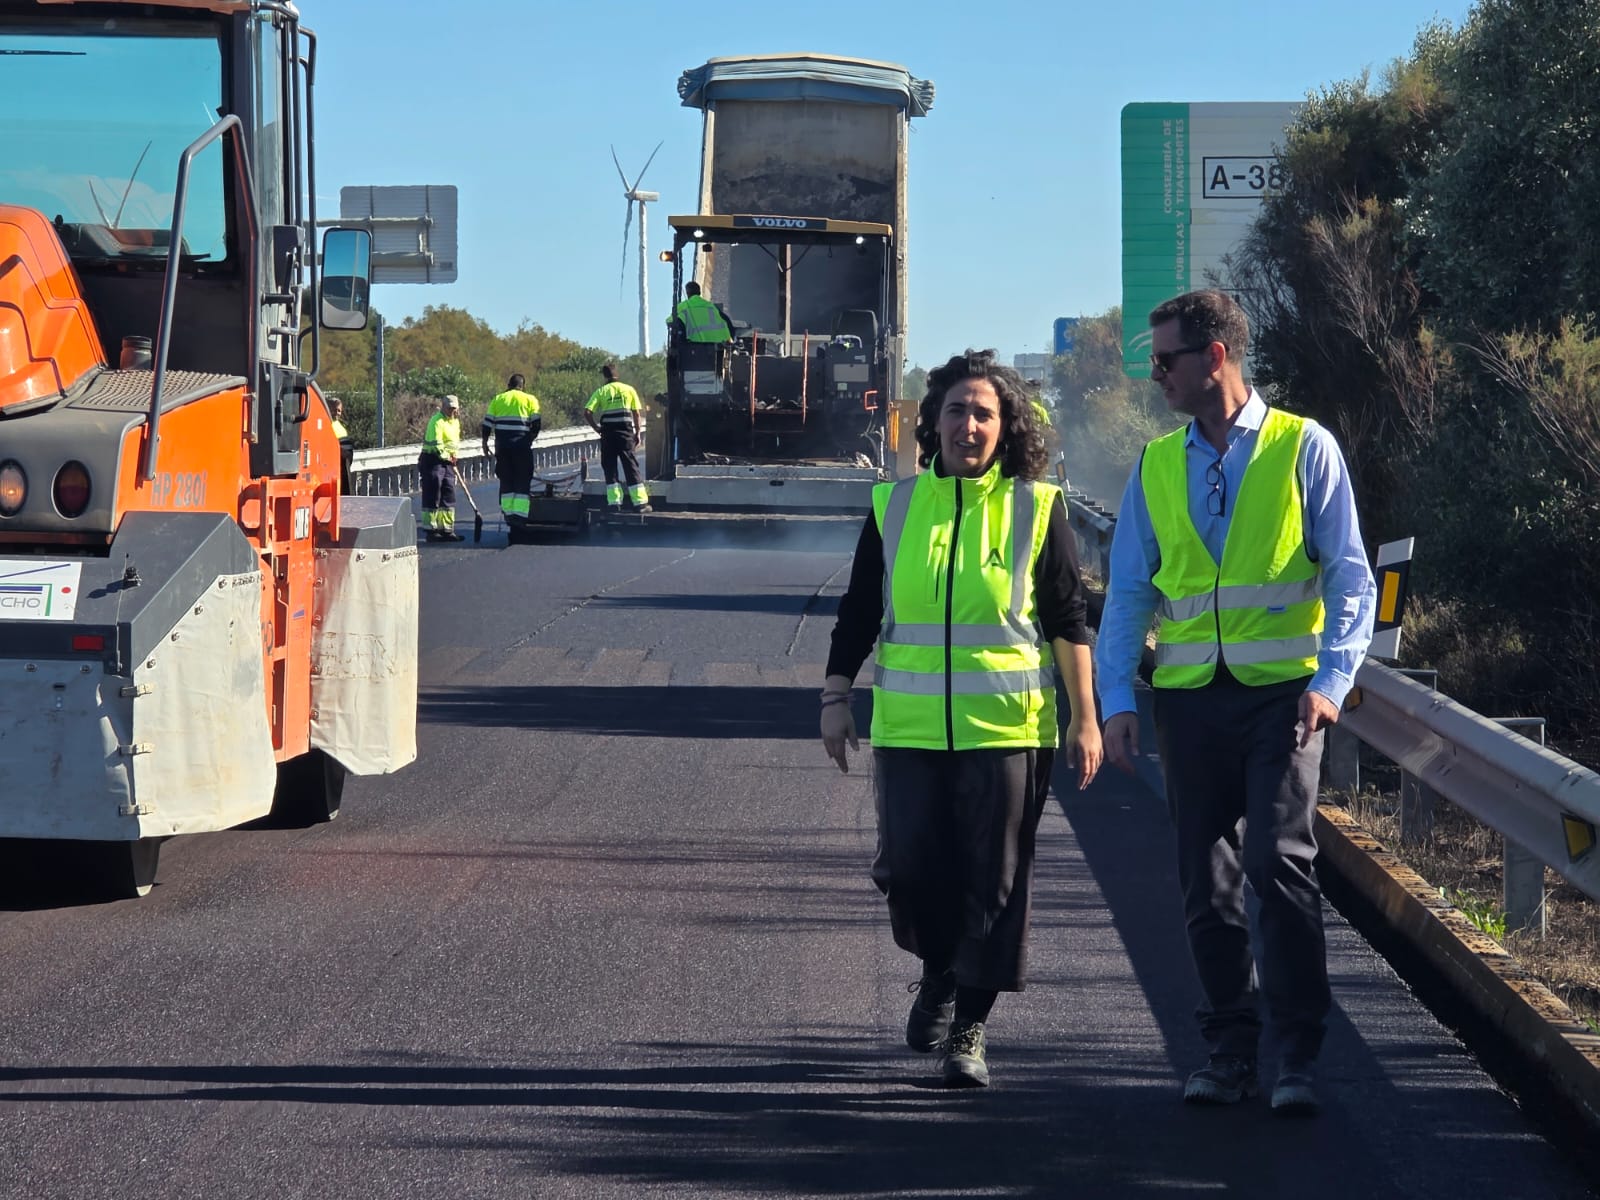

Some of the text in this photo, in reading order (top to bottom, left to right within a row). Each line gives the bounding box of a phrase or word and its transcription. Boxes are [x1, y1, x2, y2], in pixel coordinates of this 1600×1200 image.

[1163, 119, 1172, 136] DE
[1175, 119, 1185, 205] TRANSPORTES
[752, 217, 807, 228] VOLVO
[152, 469, 207, 507] HP 280i
[0, 597, 41, 608] CHO
